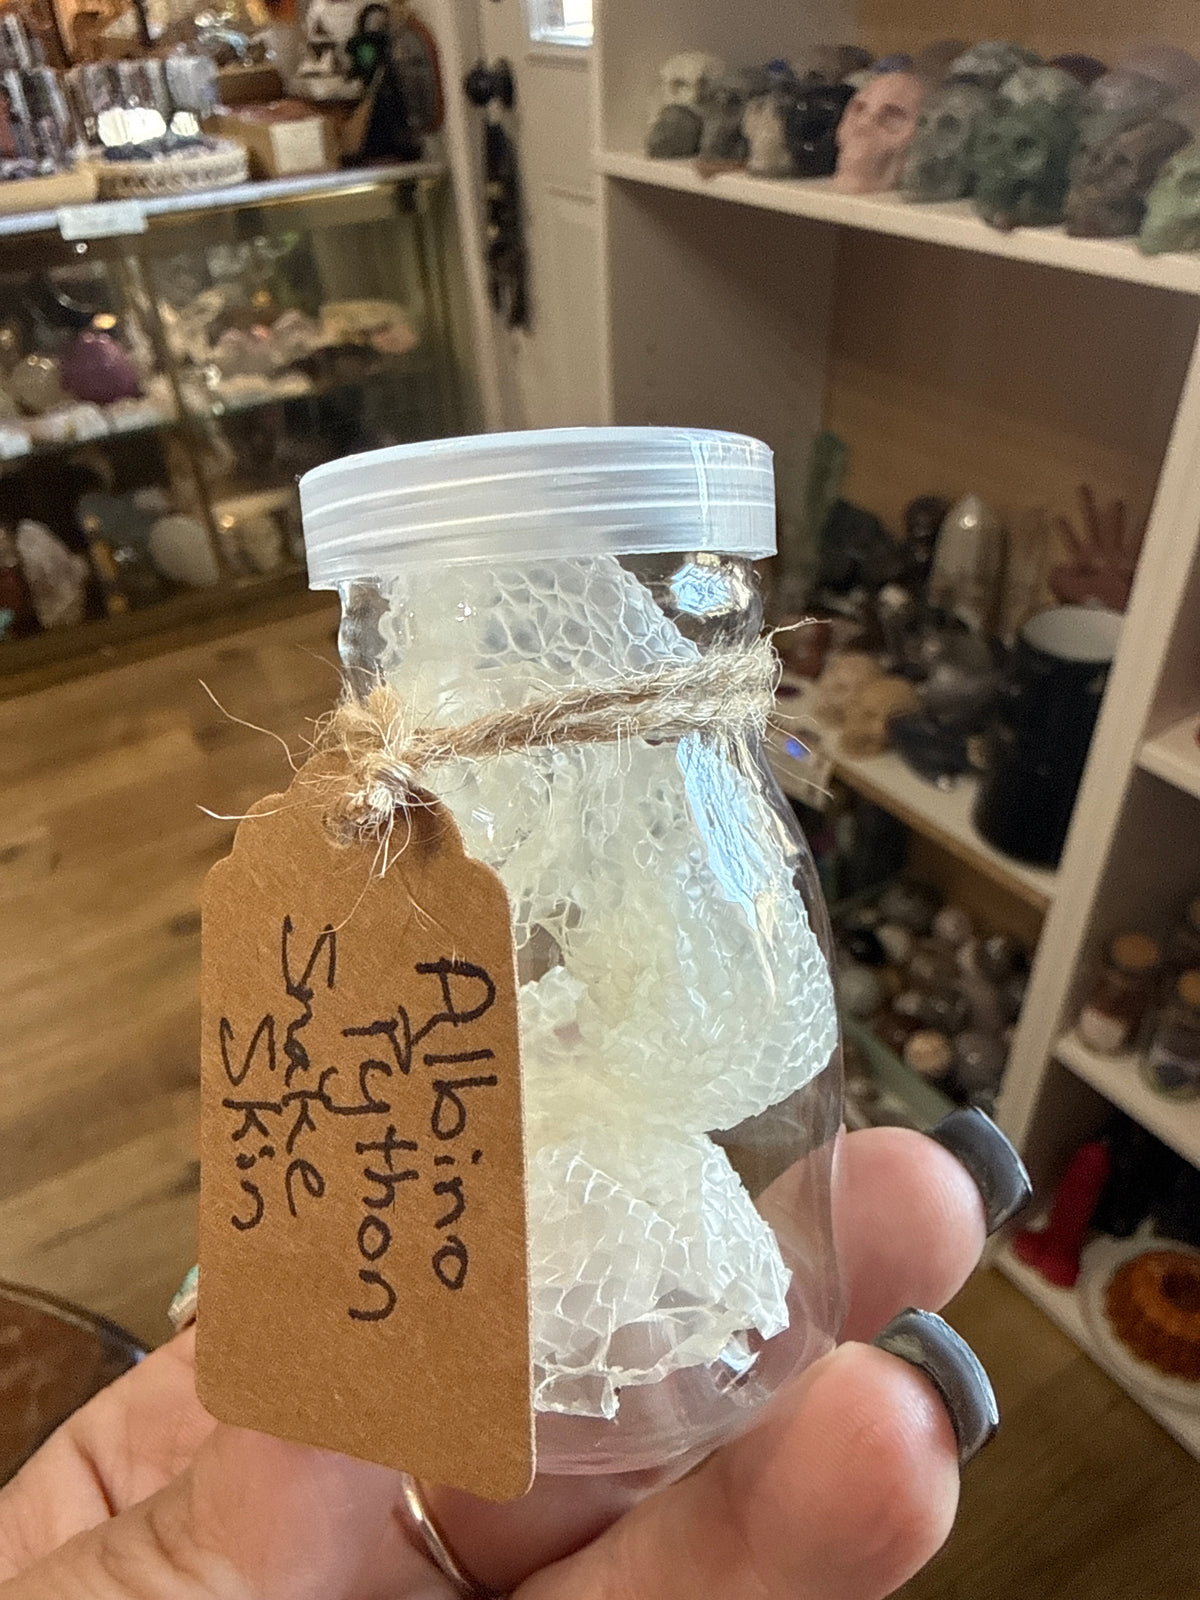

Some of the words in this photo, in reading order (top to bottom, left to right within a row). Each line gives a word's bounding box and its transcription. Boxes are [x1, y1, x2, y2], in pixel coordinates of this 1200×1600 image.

[219, 1014, 284, 1232] Skin
[280, 914, 337, 1218] Snake
[320, 1005, 420, 1322] Python
[410, 956, 498, 1291] Albino
